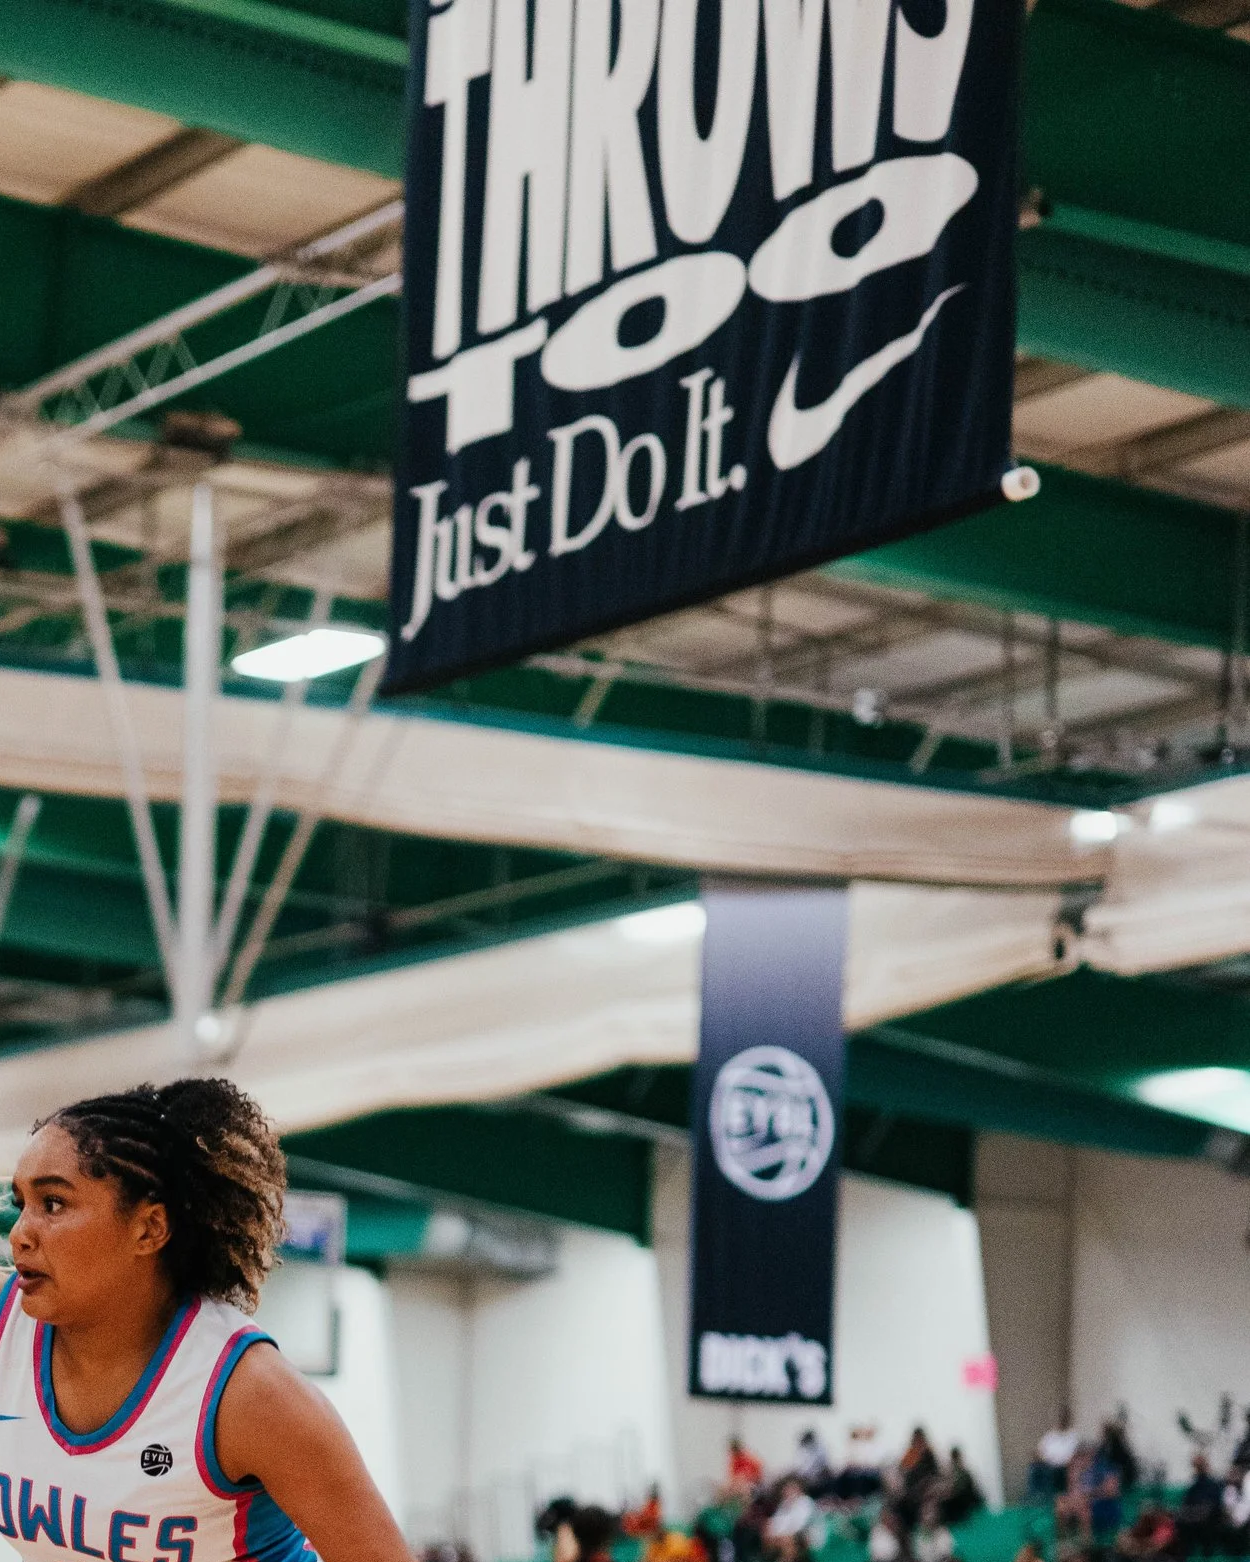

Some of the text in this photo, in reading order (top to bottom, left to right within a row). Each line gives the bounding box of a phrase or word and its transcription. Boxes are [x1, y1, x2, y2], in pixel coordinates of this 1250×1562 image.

[408, 152, 979, 455] TOO
[401, 367, 747, 642] Just Do It.
[700, 1330, 827, 1399] DICK'S
[144, 1451, 171, 1464] EYBL
